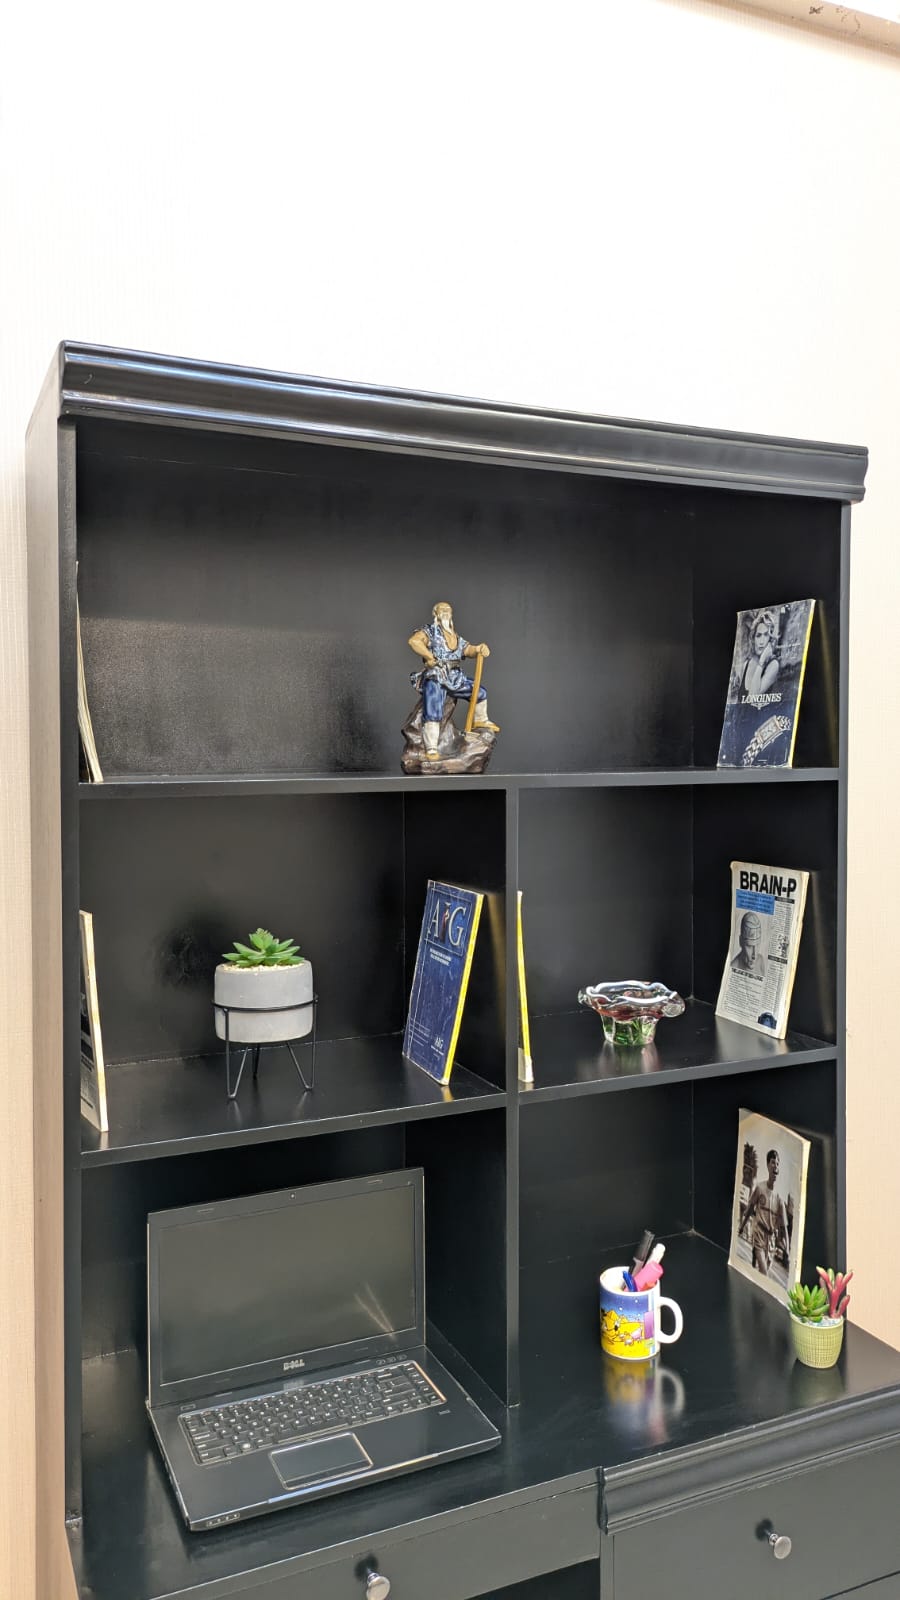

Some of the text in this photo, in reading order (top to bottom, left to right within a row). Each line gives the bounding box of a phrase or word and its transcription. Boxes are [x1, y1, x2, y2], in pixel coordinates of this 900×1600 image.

[741, 692, 782, 704] LONGINES
[740, 870, 797, 898] BRAIN-P
[283, 1359, 305, 1370] DELL
